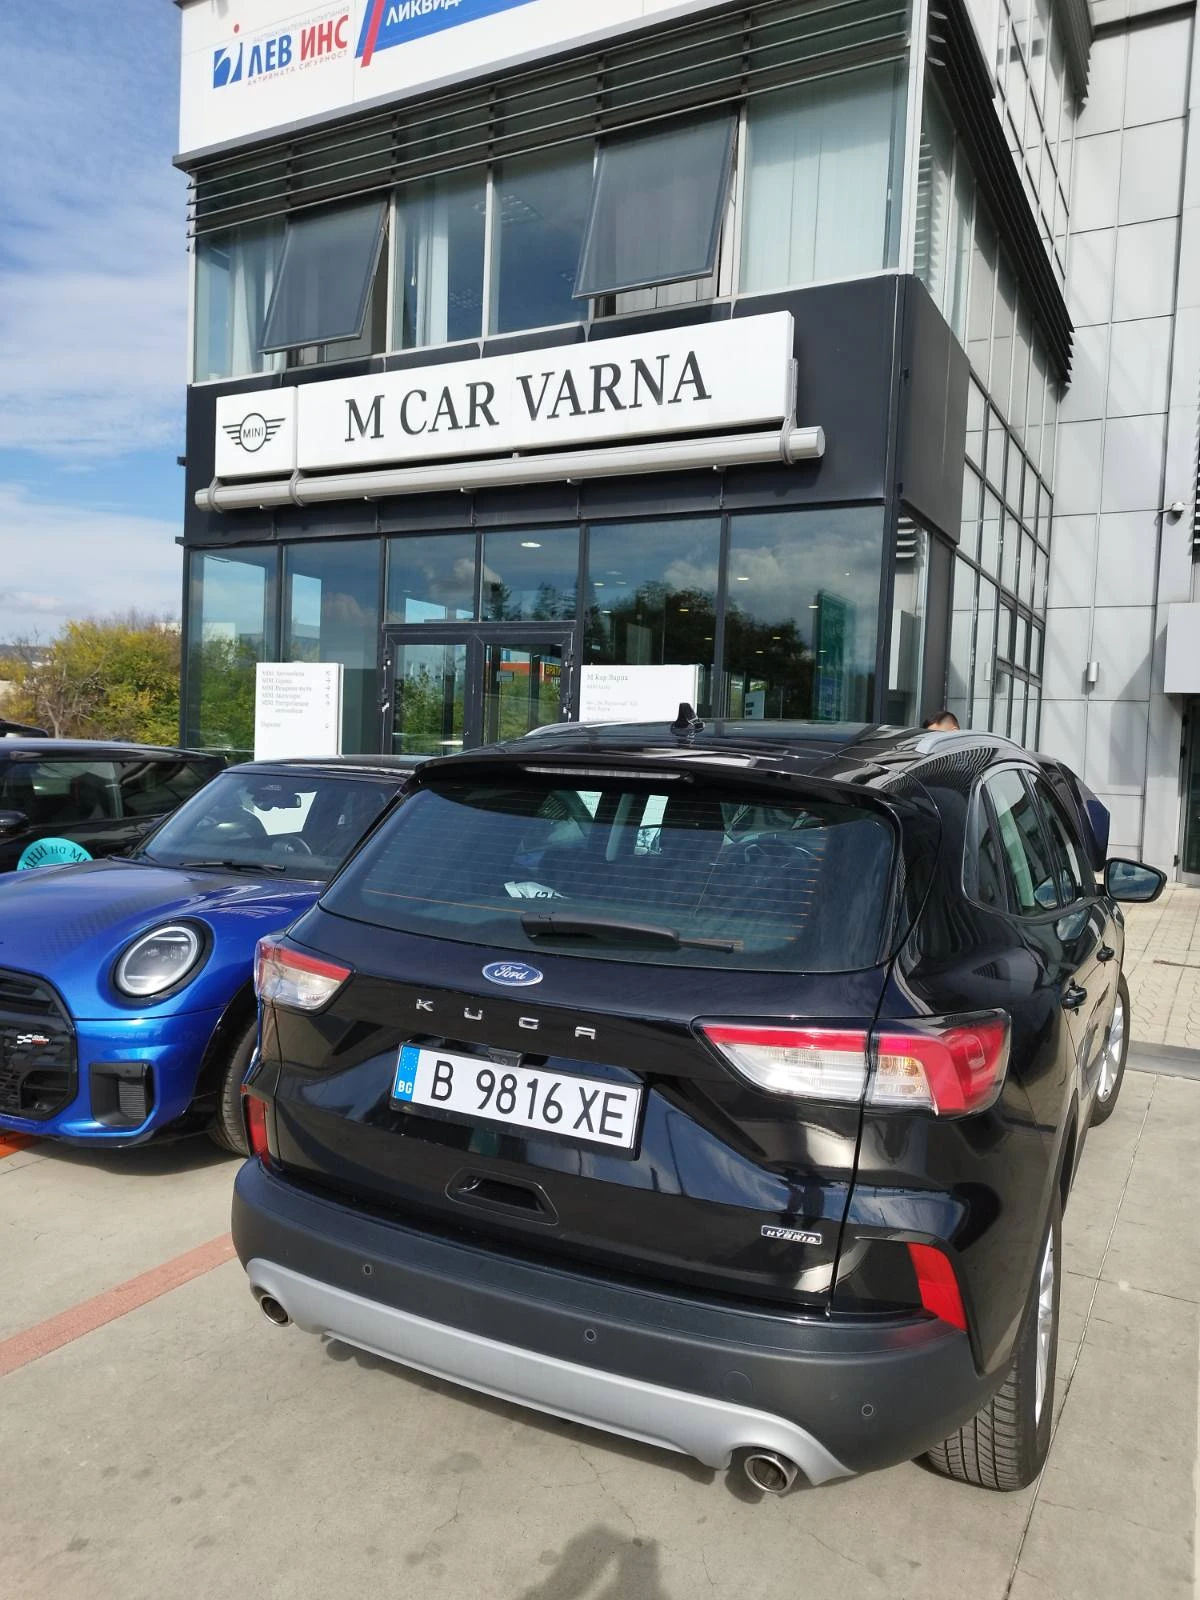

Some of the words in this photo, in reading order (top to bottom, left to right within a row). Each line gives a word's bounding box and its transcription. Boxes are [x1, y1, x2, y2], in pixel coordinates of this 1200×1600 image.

[248, 34, 292, 78] ЛЕВ
[301, 14, 349, 61] ИНС
[344, 394, 384, 442] M
[400, 381, 499, 435] CAR
[516, 350, 712, 420] VARNA
[243, 427, 264, 438] MINI
[415, 998, 596, 1040] KUGA
[397, 1080, 413, 1094] BG
[430, 1060, 454, 1101] B
[476, 1069, 563, 1124] 9816
[572, 1086, 628, 1139] XE
